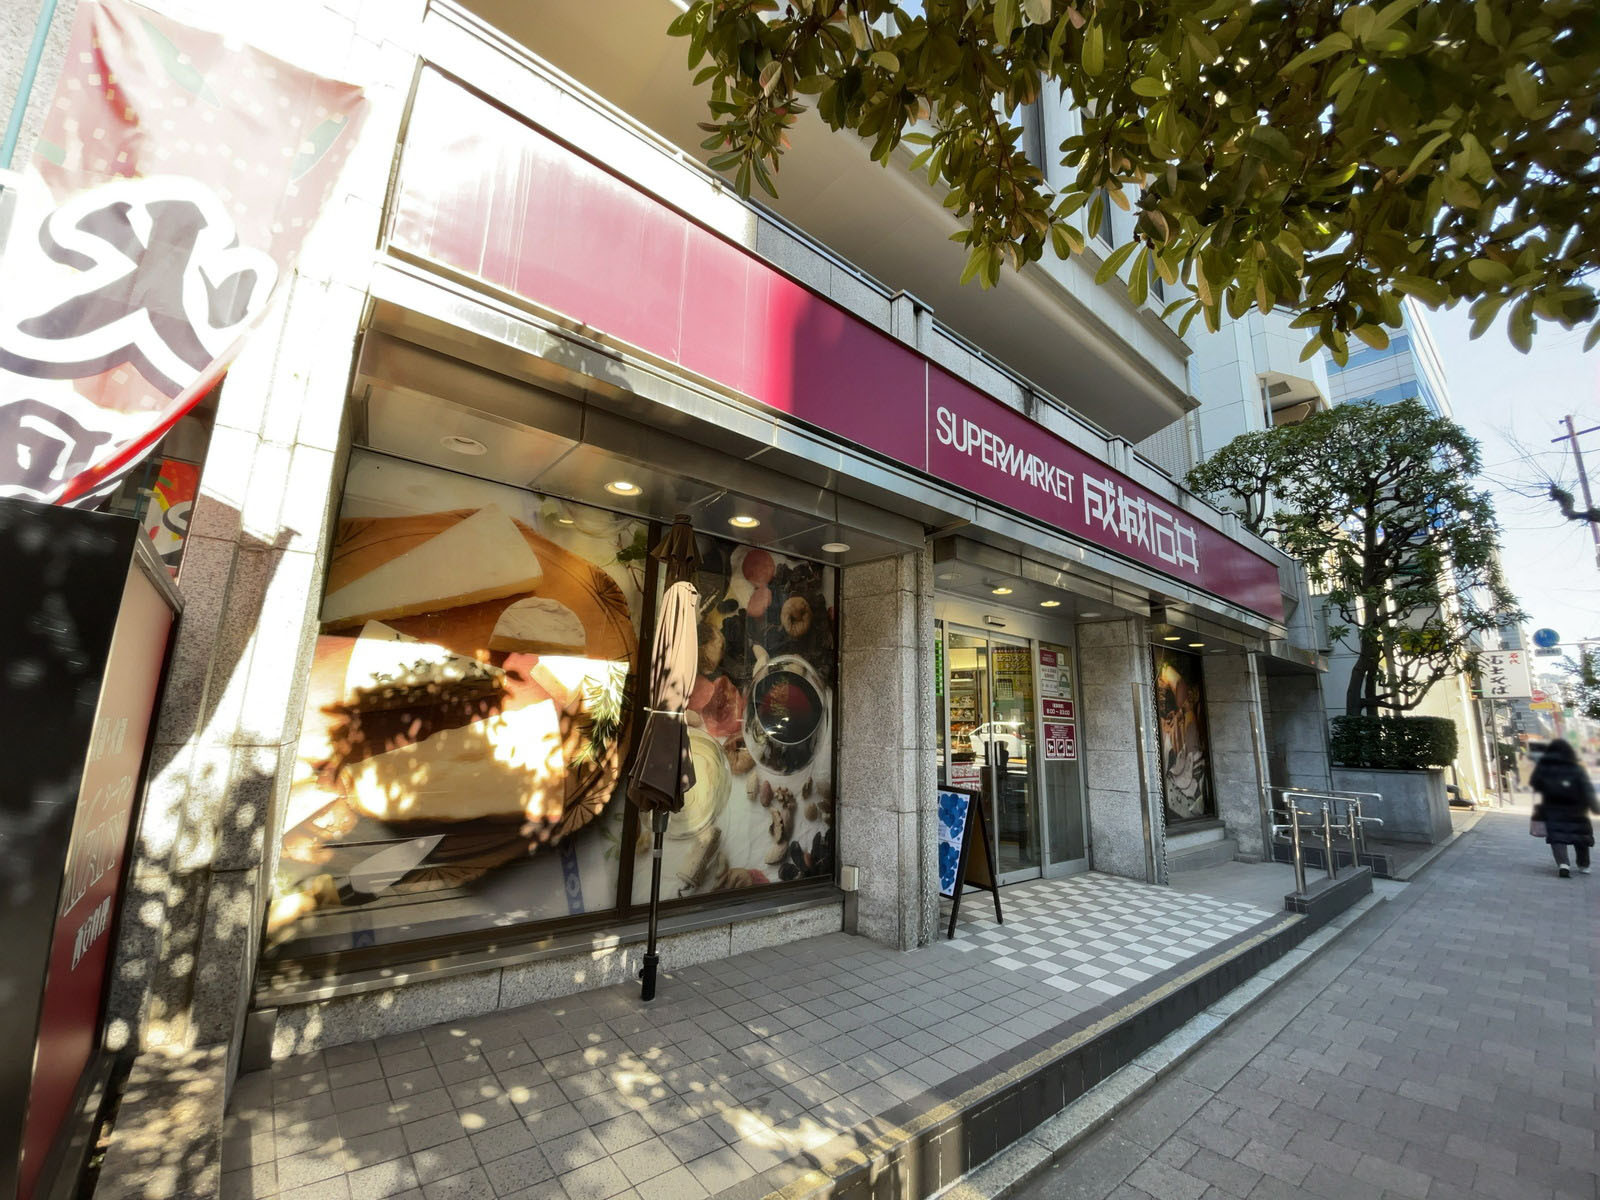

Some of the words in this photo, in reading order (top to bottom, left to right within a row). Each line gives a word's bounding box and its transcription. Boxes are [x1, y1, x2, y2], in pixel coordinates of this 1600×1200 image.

[936, 406, 1075, 504] SUPERMARKET
[1082, 472, 1200, 574] 成城石井
